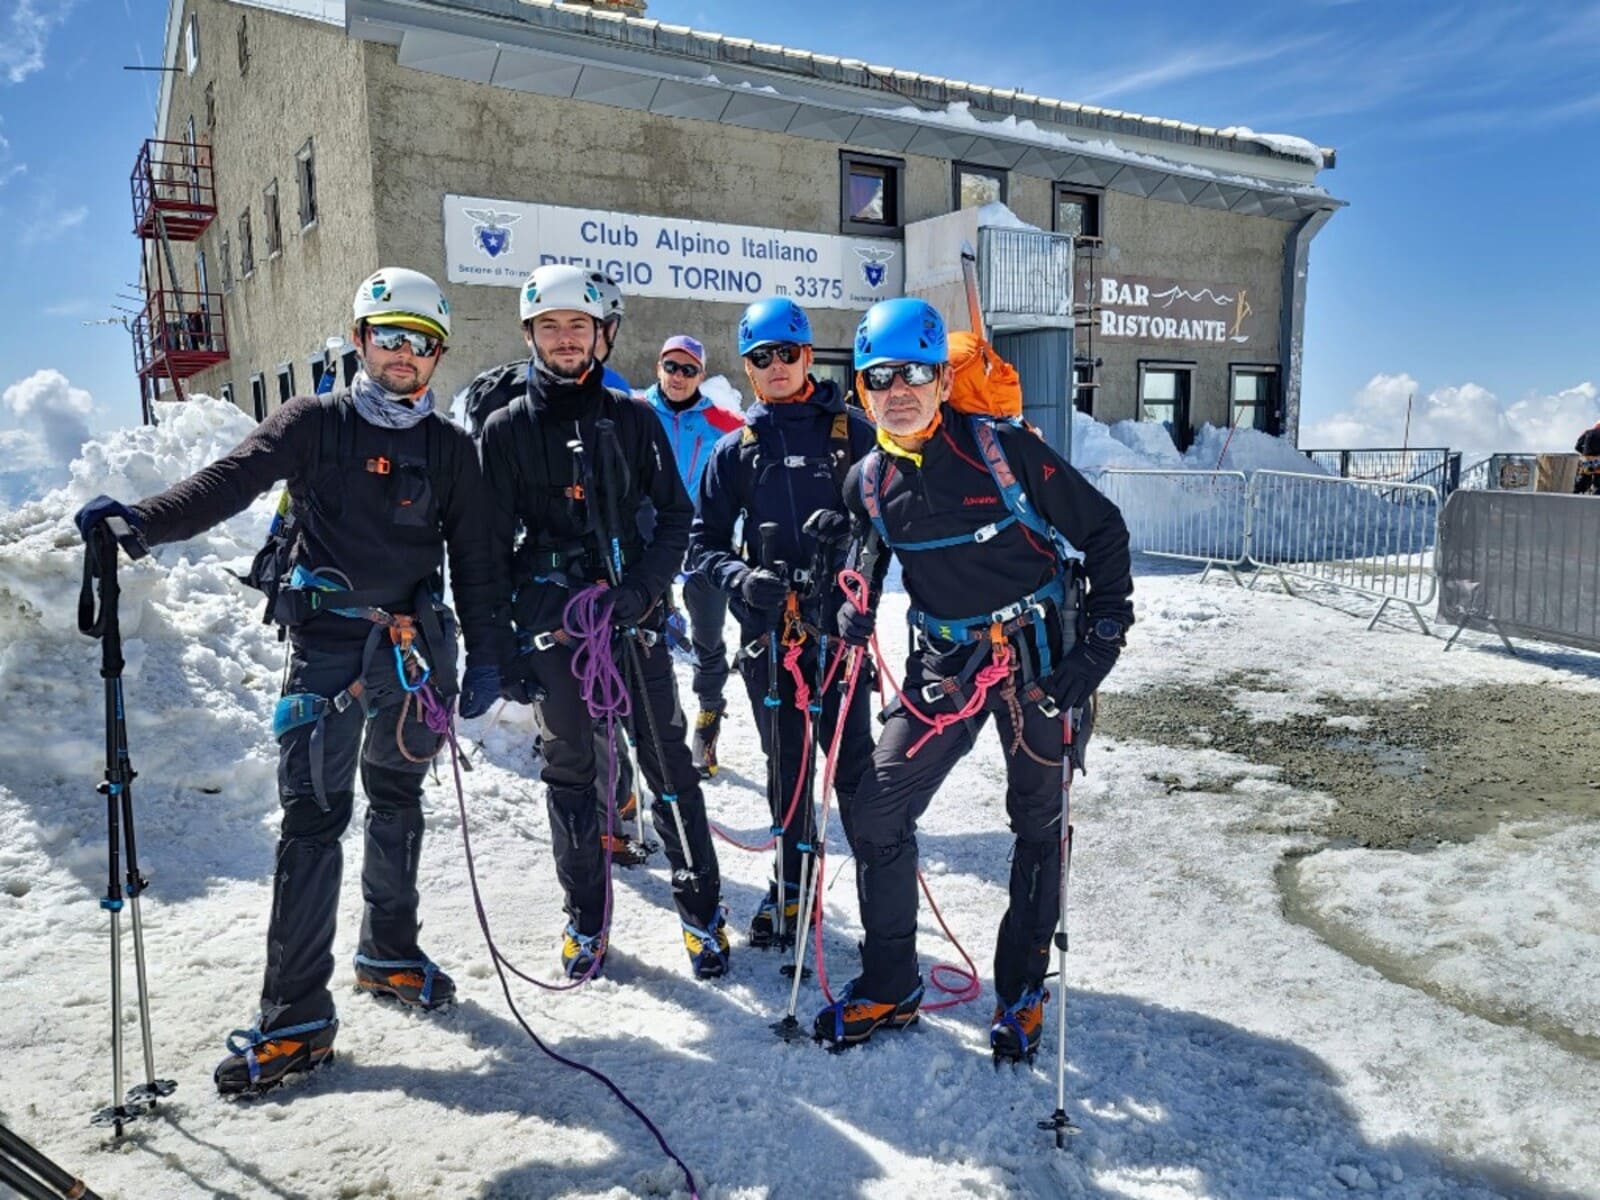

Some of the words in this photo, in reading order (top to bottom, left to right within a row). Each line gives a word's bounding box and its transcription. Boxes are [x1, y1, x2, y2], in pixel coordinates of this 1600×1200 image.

[580, 221, 639, 247] Club
[655, 228, 730, 257] Alpino
[742, 237, 818, 263] Italiano
[668, 265, 762, 293] TORINO
[794, 276, 843, 299] 3375
[1100, 277, 1150, 307] BAR
[1100, 310, 1226, 342] RISTORANTE
